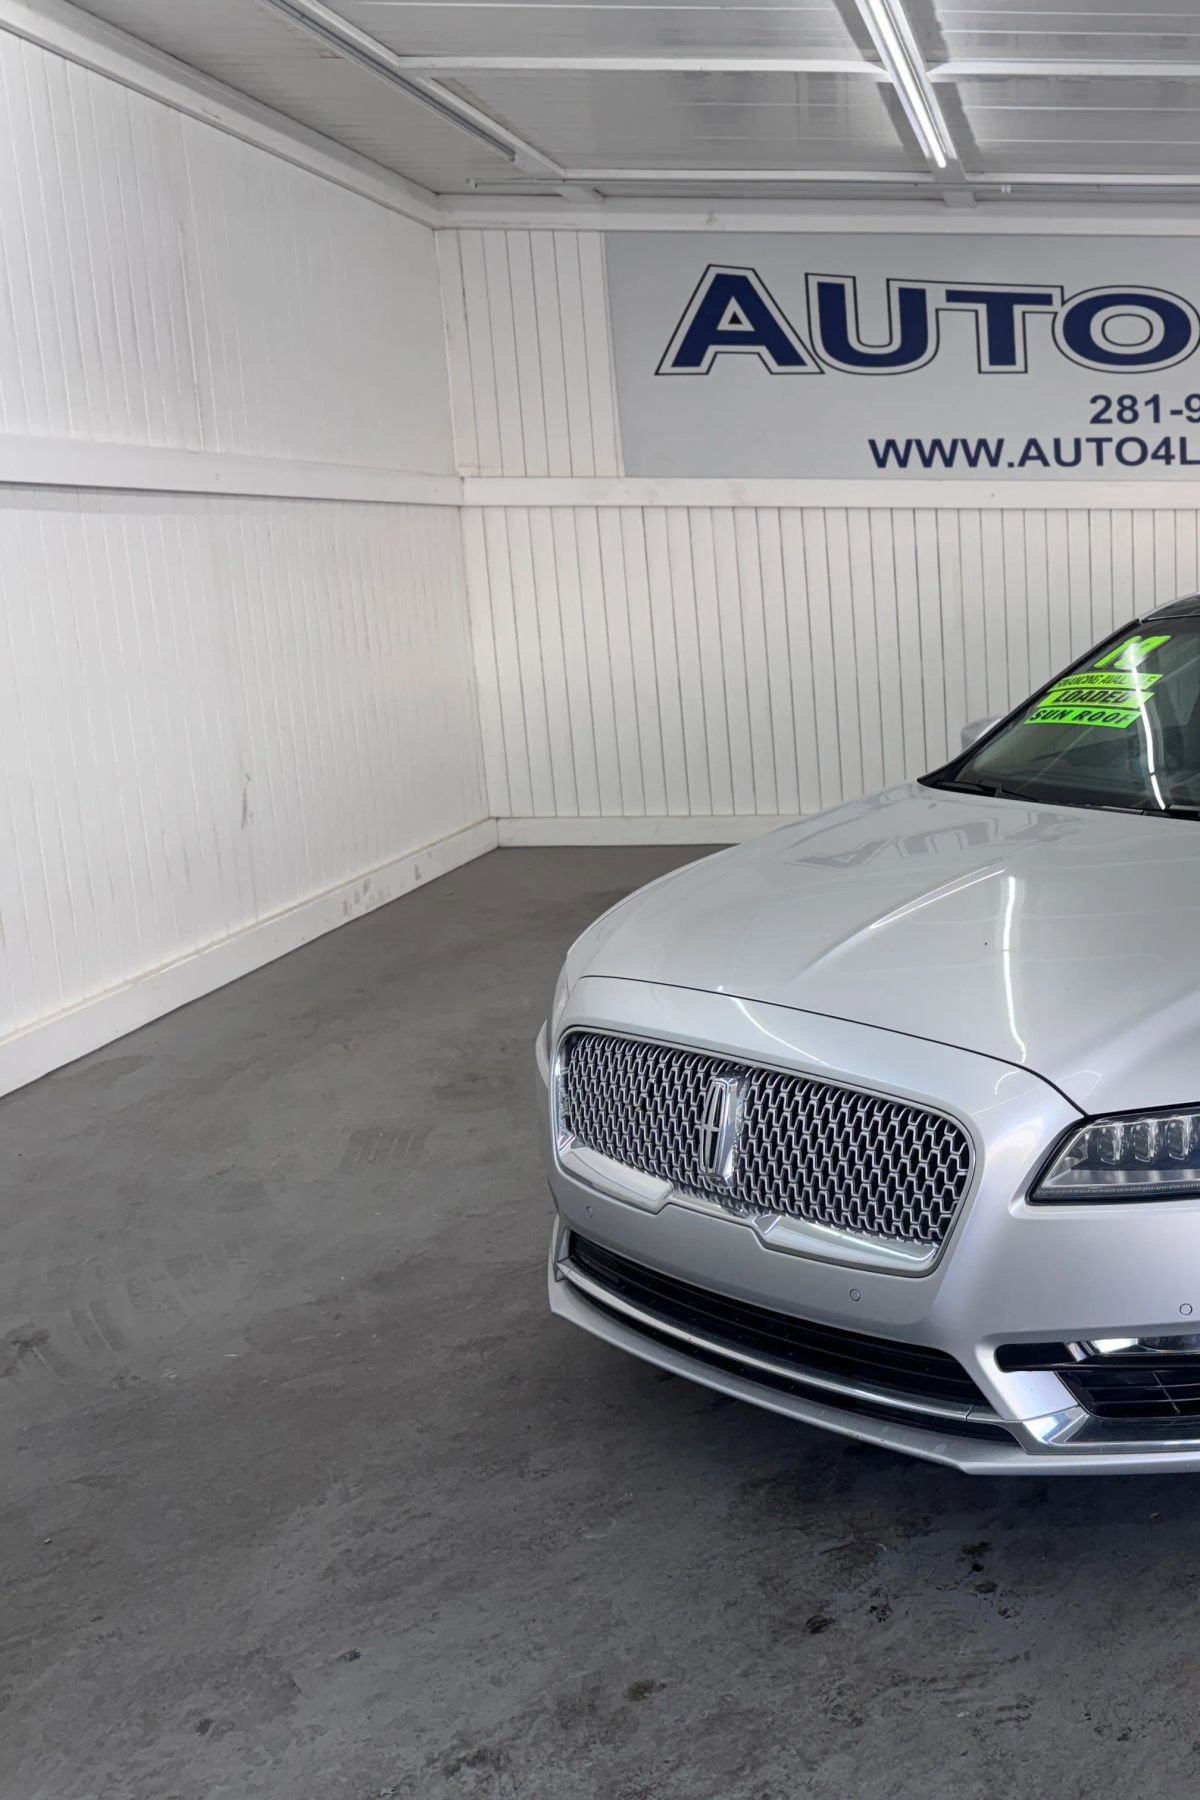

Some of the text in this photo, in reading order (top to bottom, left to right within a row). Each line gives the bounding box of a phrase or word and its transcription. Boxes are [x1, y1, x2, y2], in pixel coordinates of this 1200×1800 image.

[1100, 674, 1158, 686] AVAILE
[1030, 708, 1133, 724] SUN ROOF
